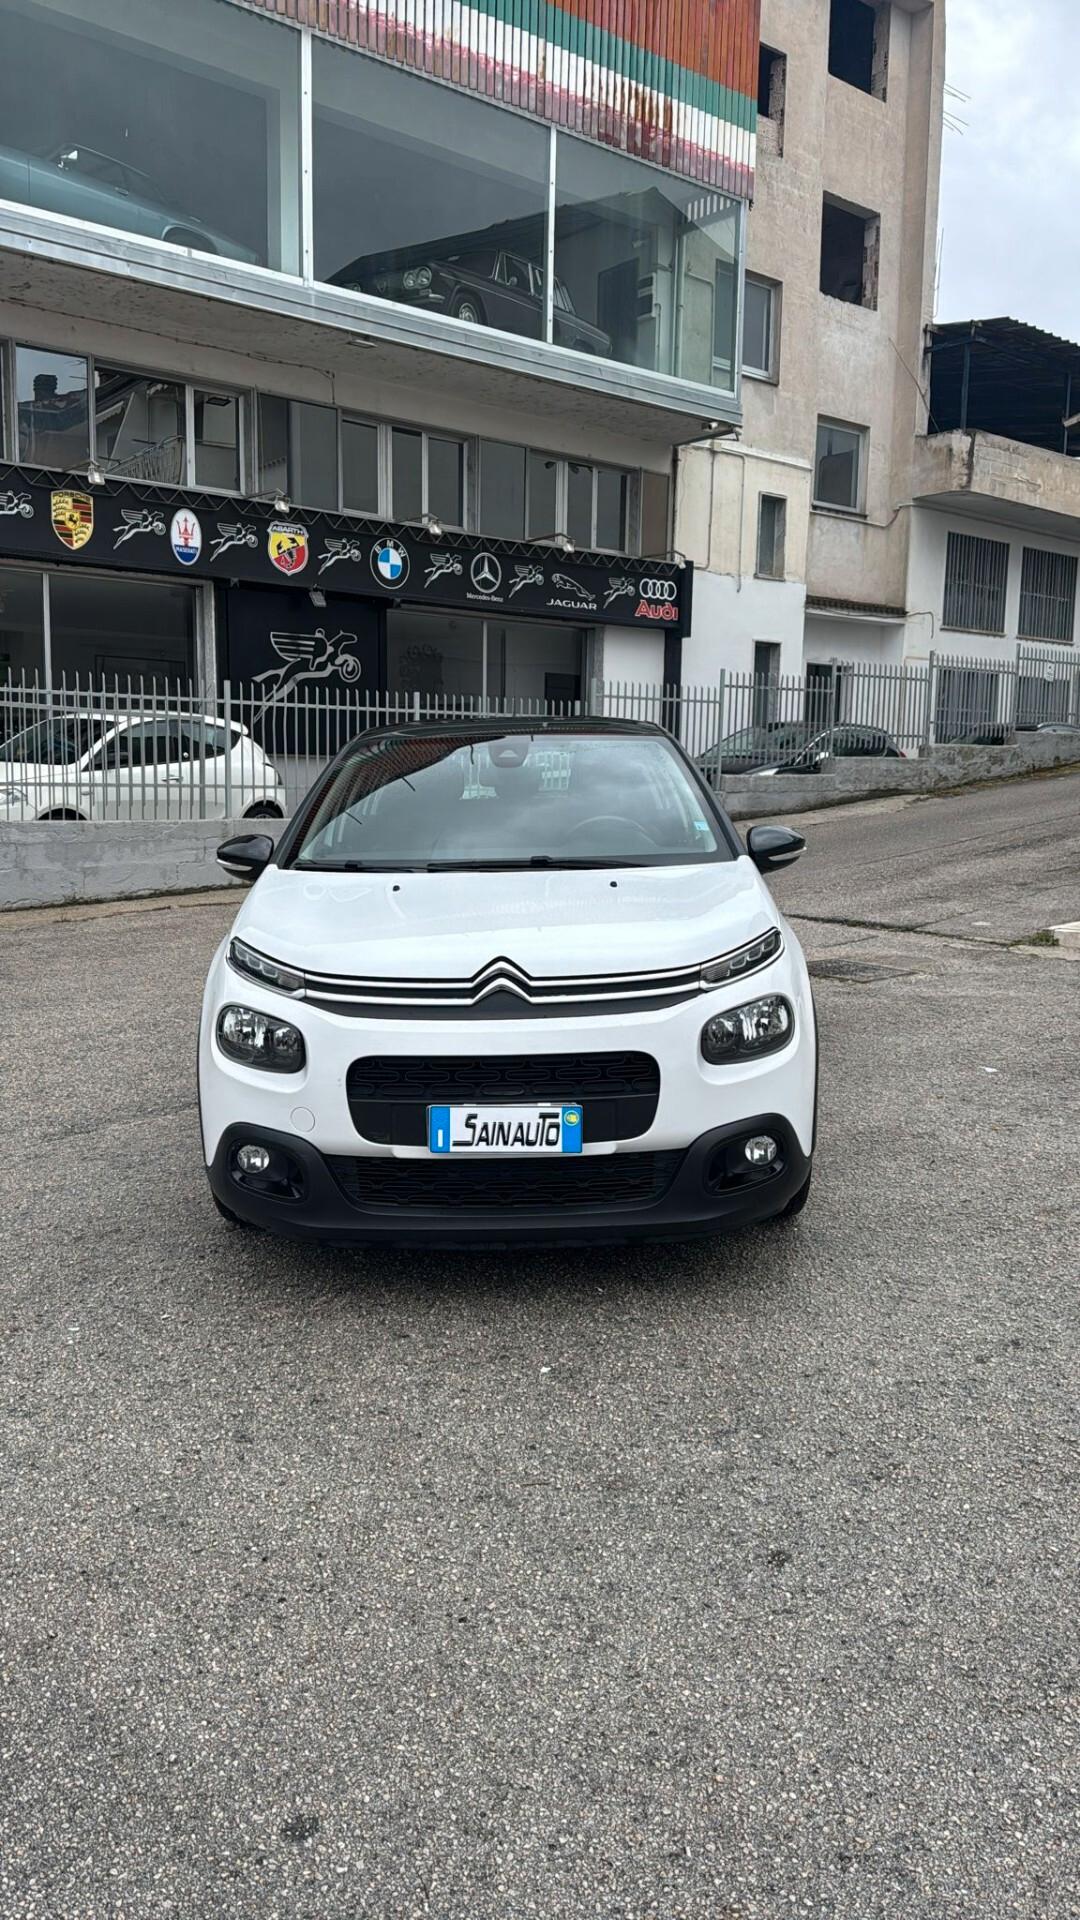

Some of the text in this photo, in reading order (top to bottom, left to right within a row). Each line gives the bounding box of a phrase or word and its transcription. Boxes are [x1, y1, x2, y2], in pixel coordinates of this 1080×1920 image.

[272, 525, 305, 535] ABARTH
[374, 539, 407, 557] BMW
[466, 591, 504, 602] Mercedes-Benz
[546, 598, 598, 611] JAGUAR
[635, 599, 679, 621] Audi
[452, 1112, 560, 1146] SAINAUTO
